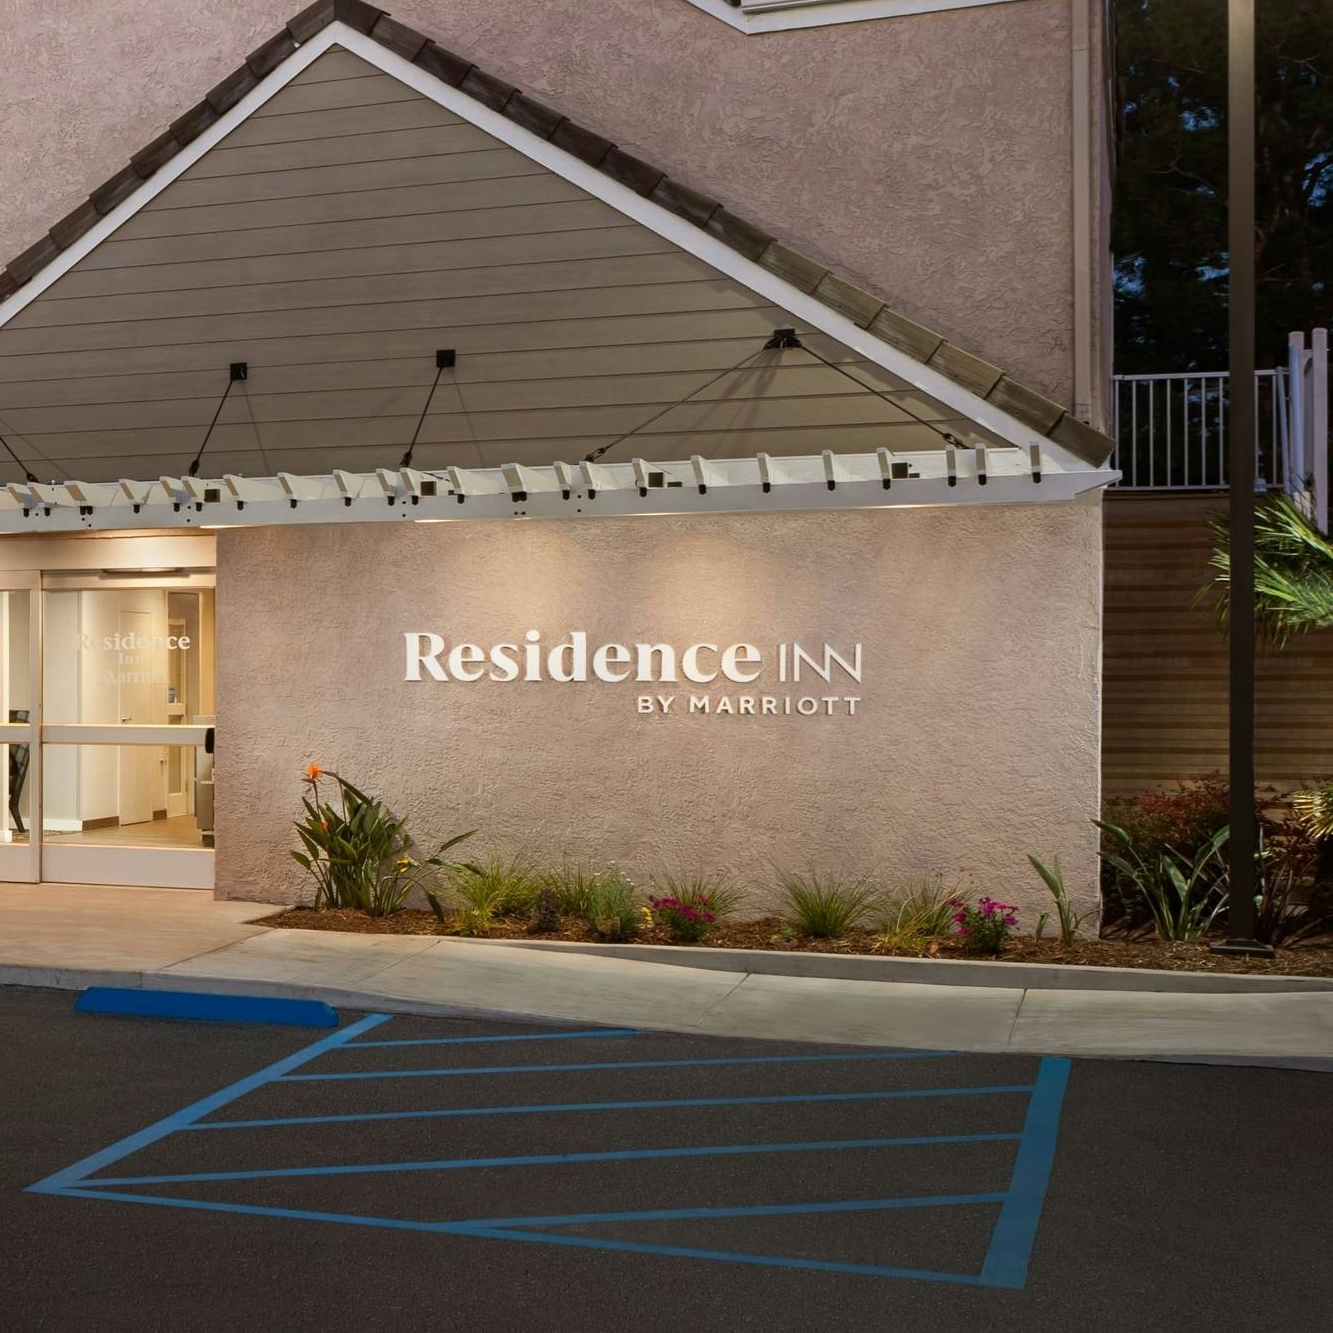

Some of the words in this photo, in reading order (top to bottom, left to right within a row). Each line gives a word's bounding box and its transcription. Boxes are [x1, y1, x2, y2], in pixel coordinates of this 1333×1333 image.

[77, 632, 191, 651] Rsidence
[403, 629, 761, 683] Residence
[779, 642, 862, 683] INN
[637, 696, 675, 714] BY
[689, 695, 862, 715] MARRIOTT
